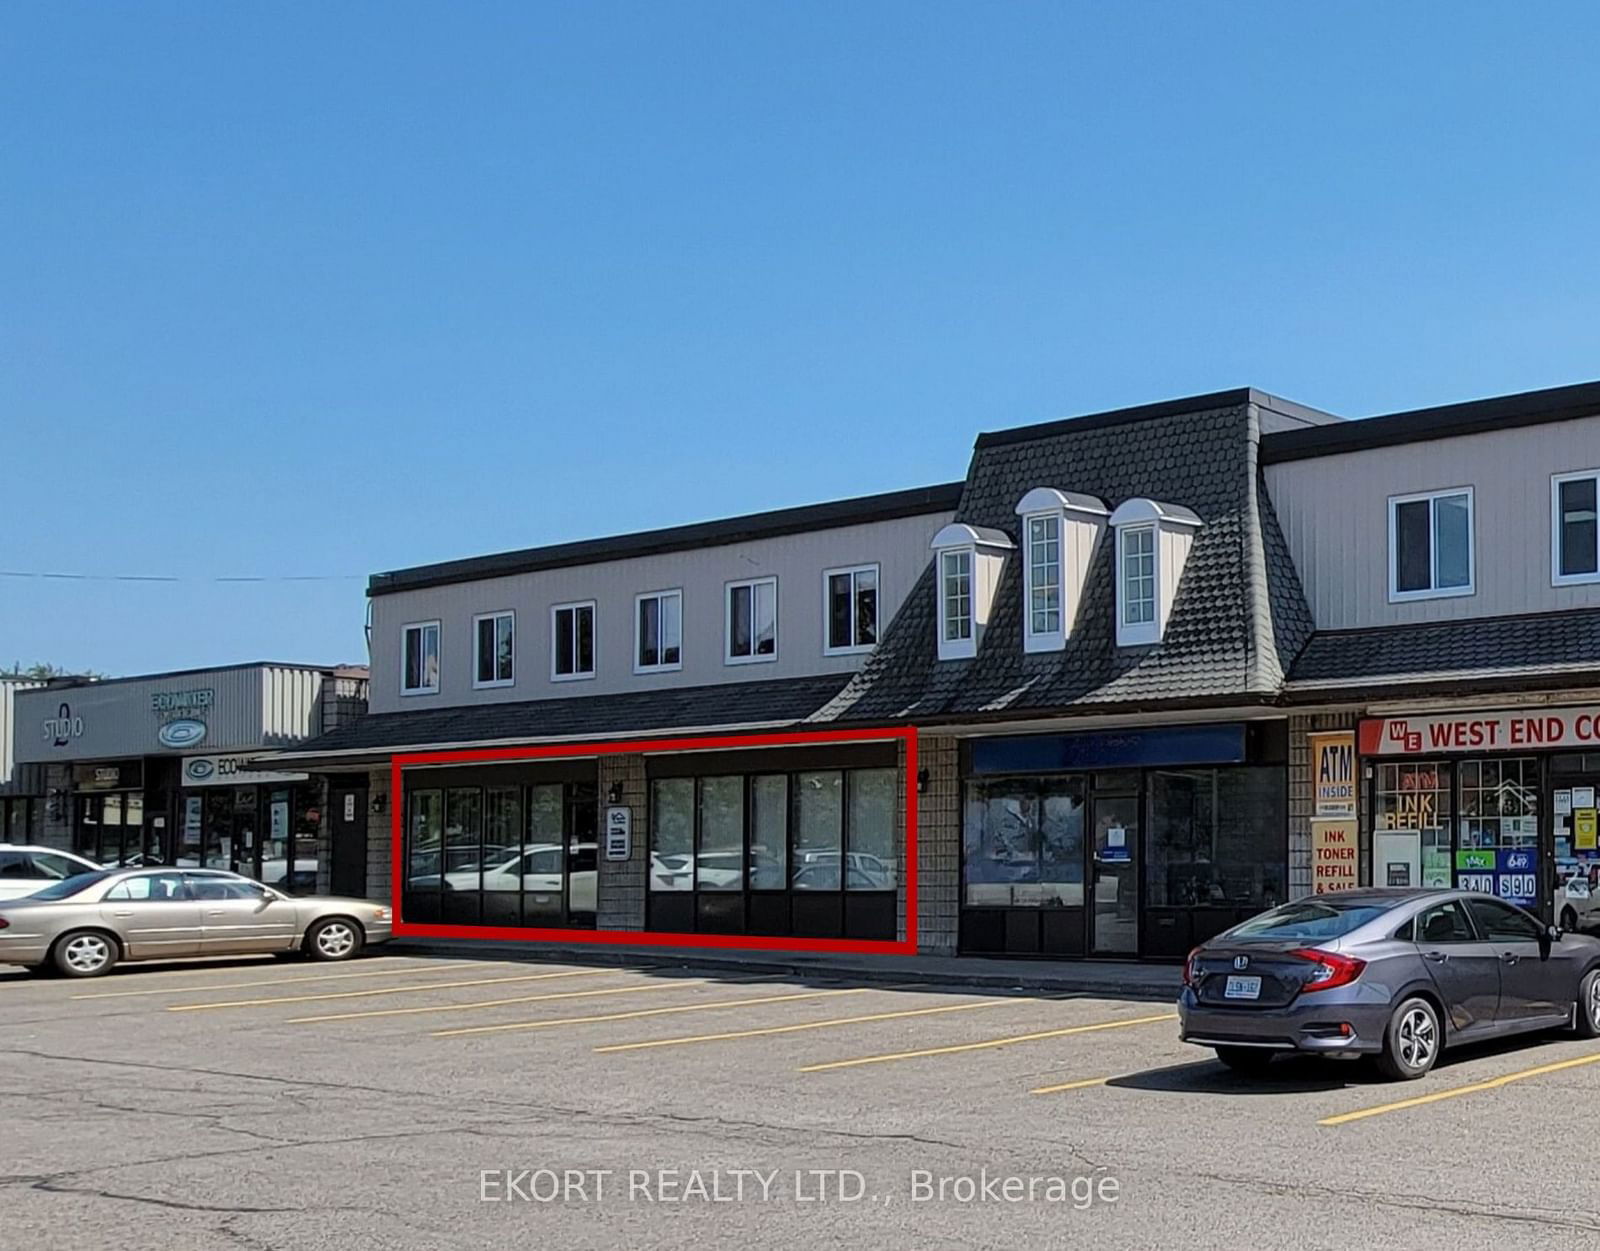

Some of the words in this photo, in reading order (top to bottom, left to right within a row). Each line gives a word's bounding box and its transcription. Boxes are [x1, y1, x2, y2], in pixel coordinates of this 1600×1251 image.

[43, 717, 83, 739] STUDIO
[1429, 721, 1500, 747] WEST
[1510, 717, 1564, 744] END
[1319, 744, 1353, 783] ATM
[1318, 785, 1353, 798] INSIDE
[1398, 794, 1433, 813] INK
[1384, 812, 1444, 830] REFILL
[1324, 830, 1345, 842] INK
[1316, 847, 1355, 860] TONER
[1316, 865, 1355, 878] REFILL
[1316, 882, 1325, 895] &
